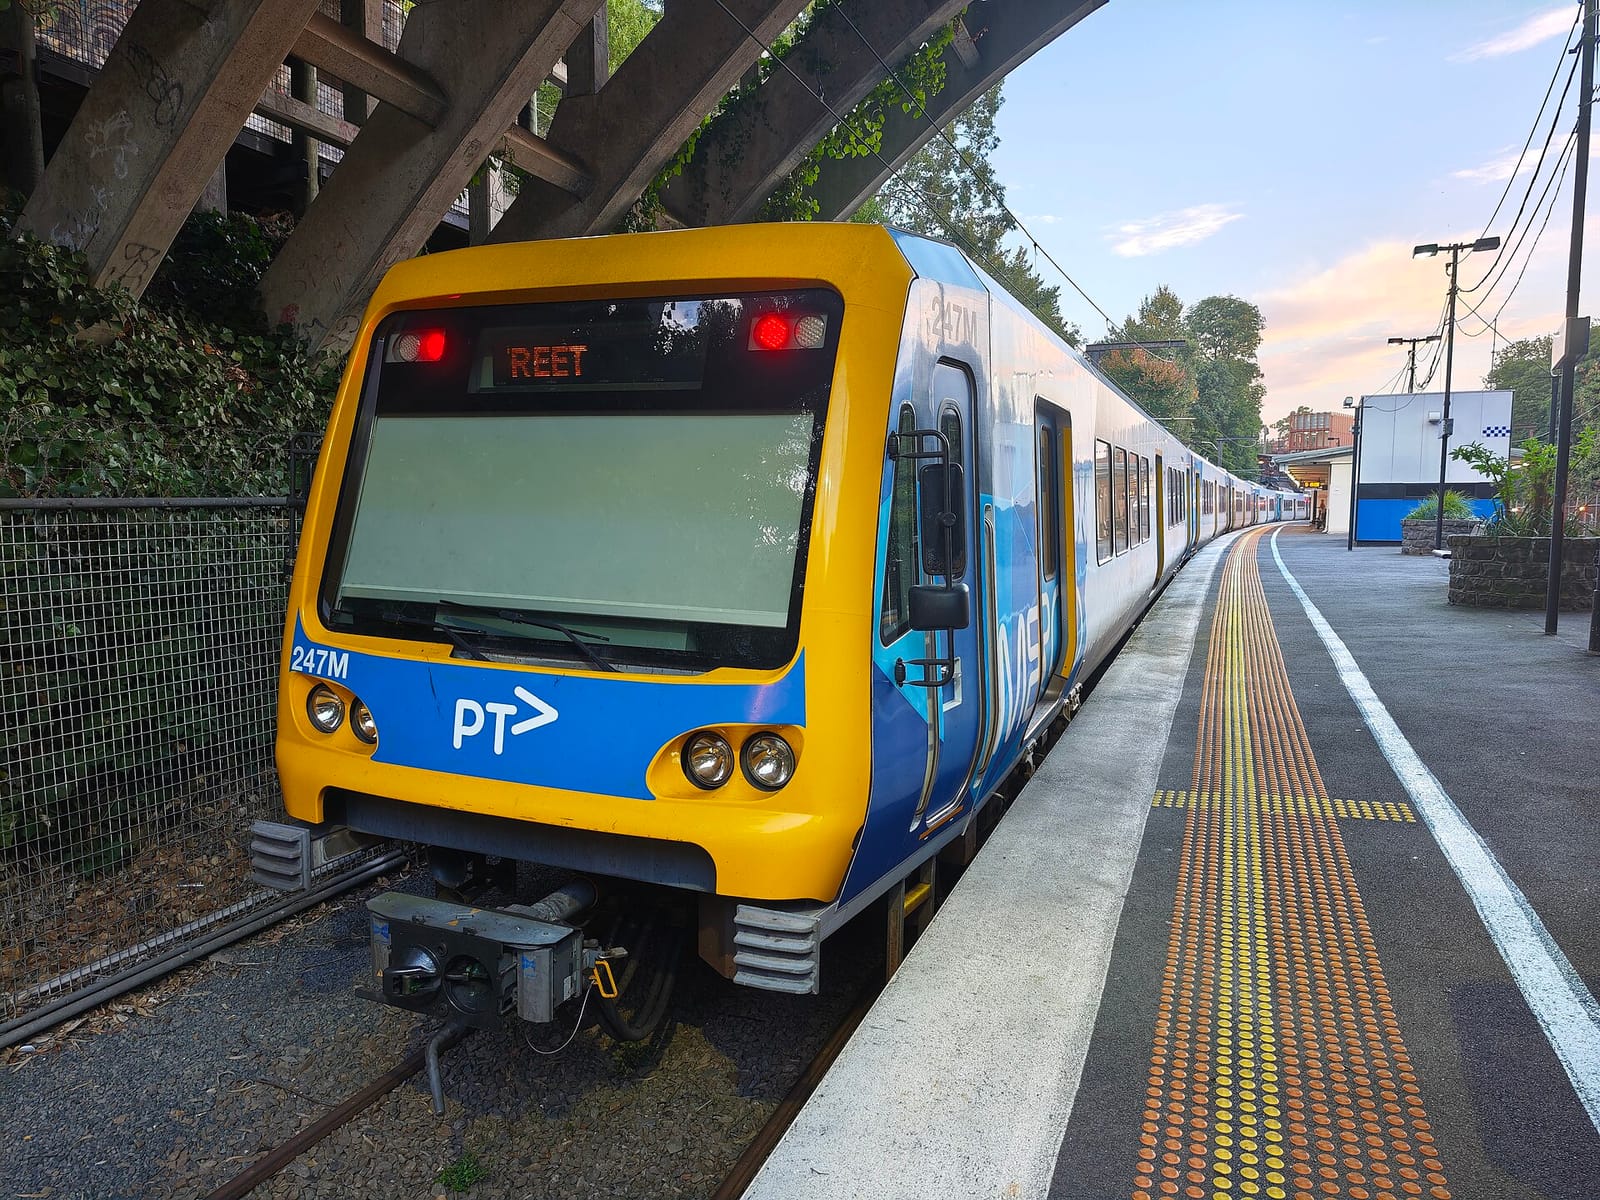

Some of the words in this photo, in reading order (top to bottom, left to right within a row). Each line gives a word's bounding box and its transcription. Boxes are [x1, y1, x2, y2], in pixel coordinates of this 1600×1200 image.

[931, 296, 977, 347] 247M
[506, 344, 588, 378] REET
[291, 645, 349, 679] 247M
